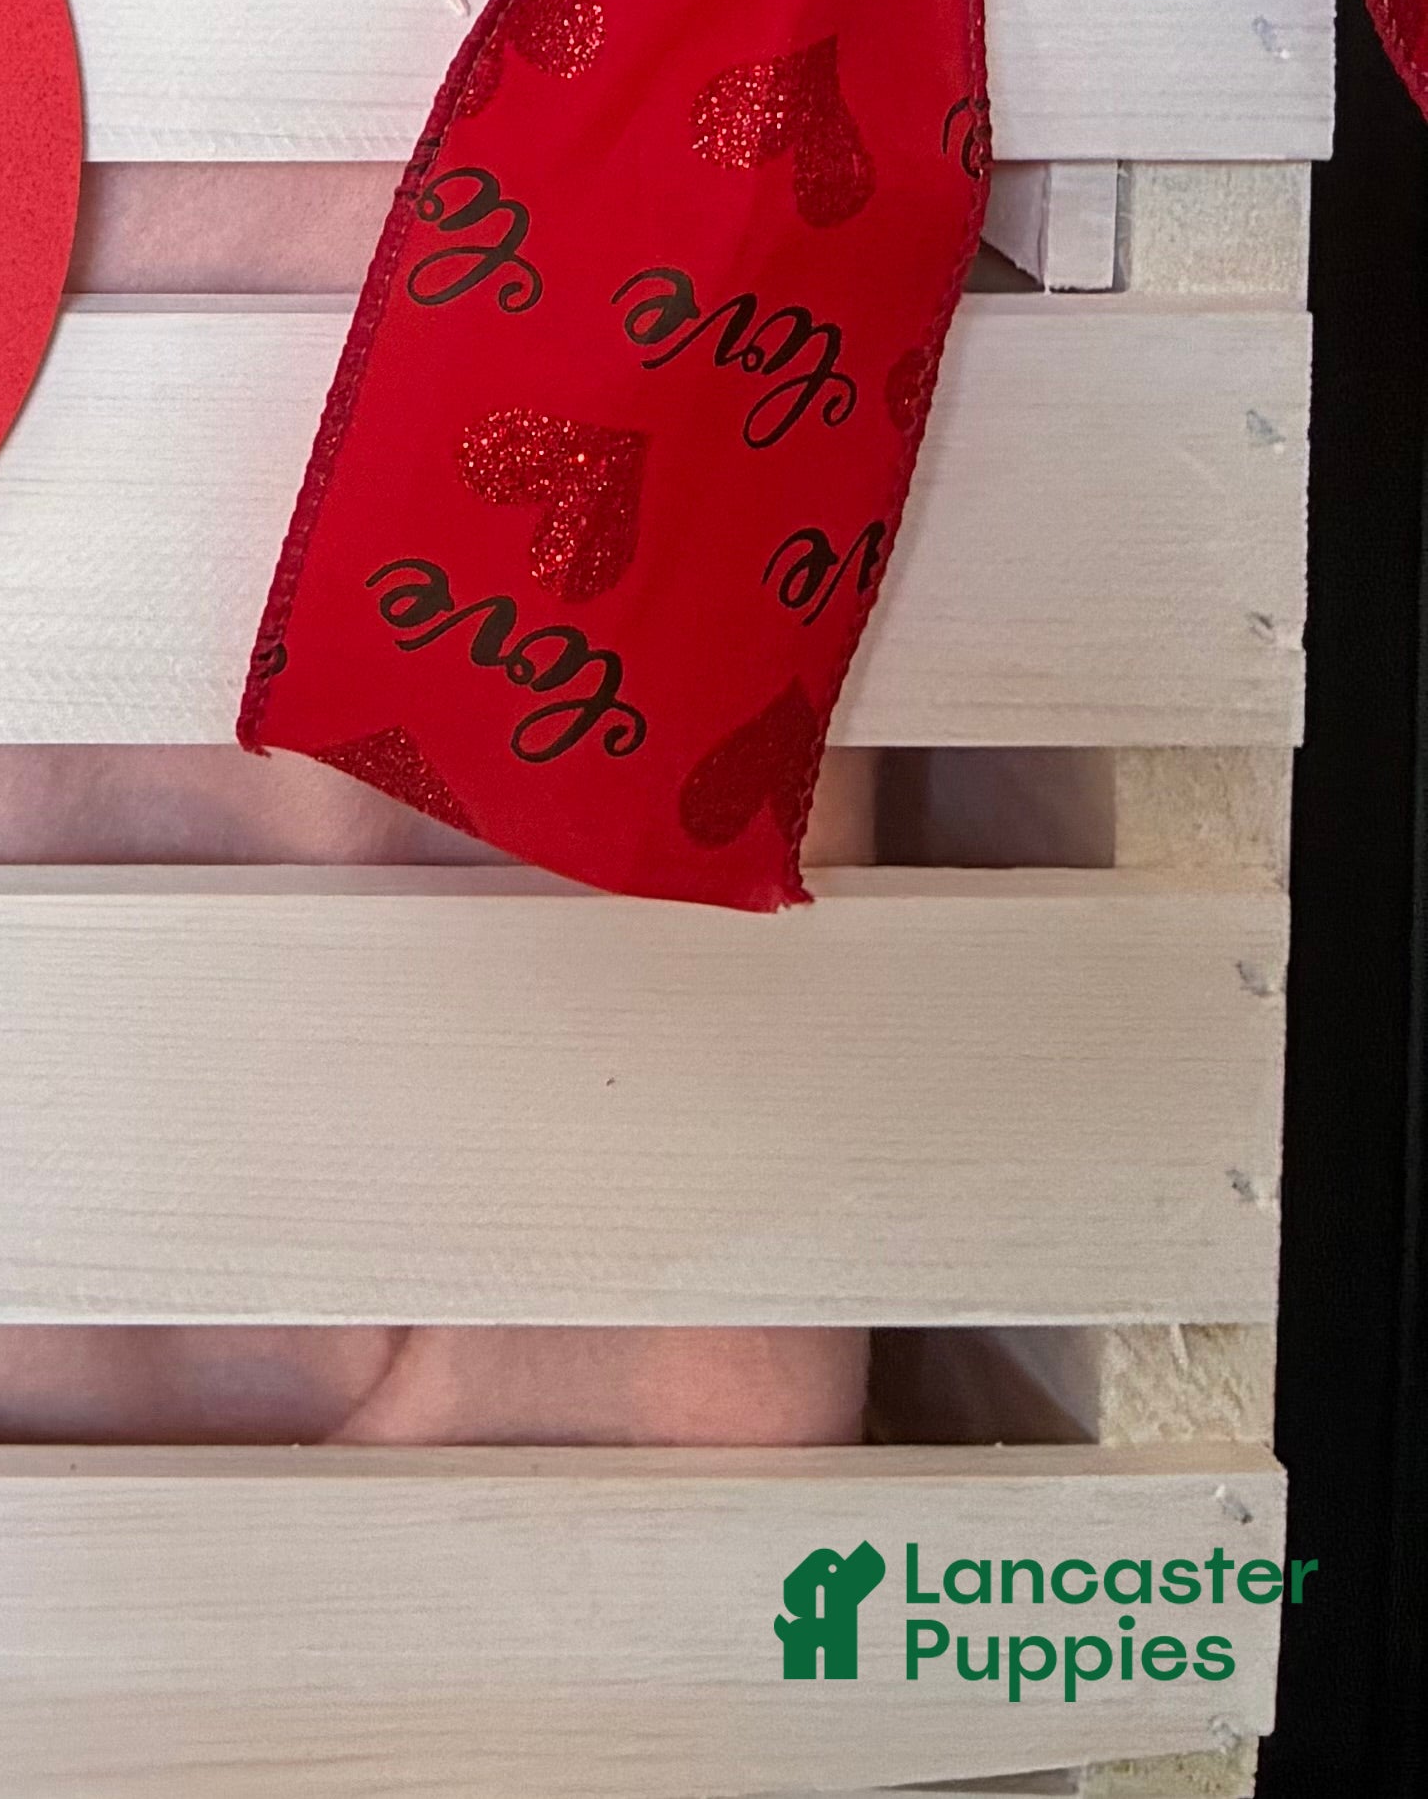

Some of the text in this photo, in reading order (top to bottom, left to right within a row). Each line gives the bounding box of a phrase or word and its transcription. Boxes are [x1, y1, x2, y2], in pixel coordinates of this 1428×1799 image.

[409, 166, 544, 313] lo
[611, 266, 859, 450] love
[764, 525, 889, 625] ve
[366, 558, 648, 765] love
